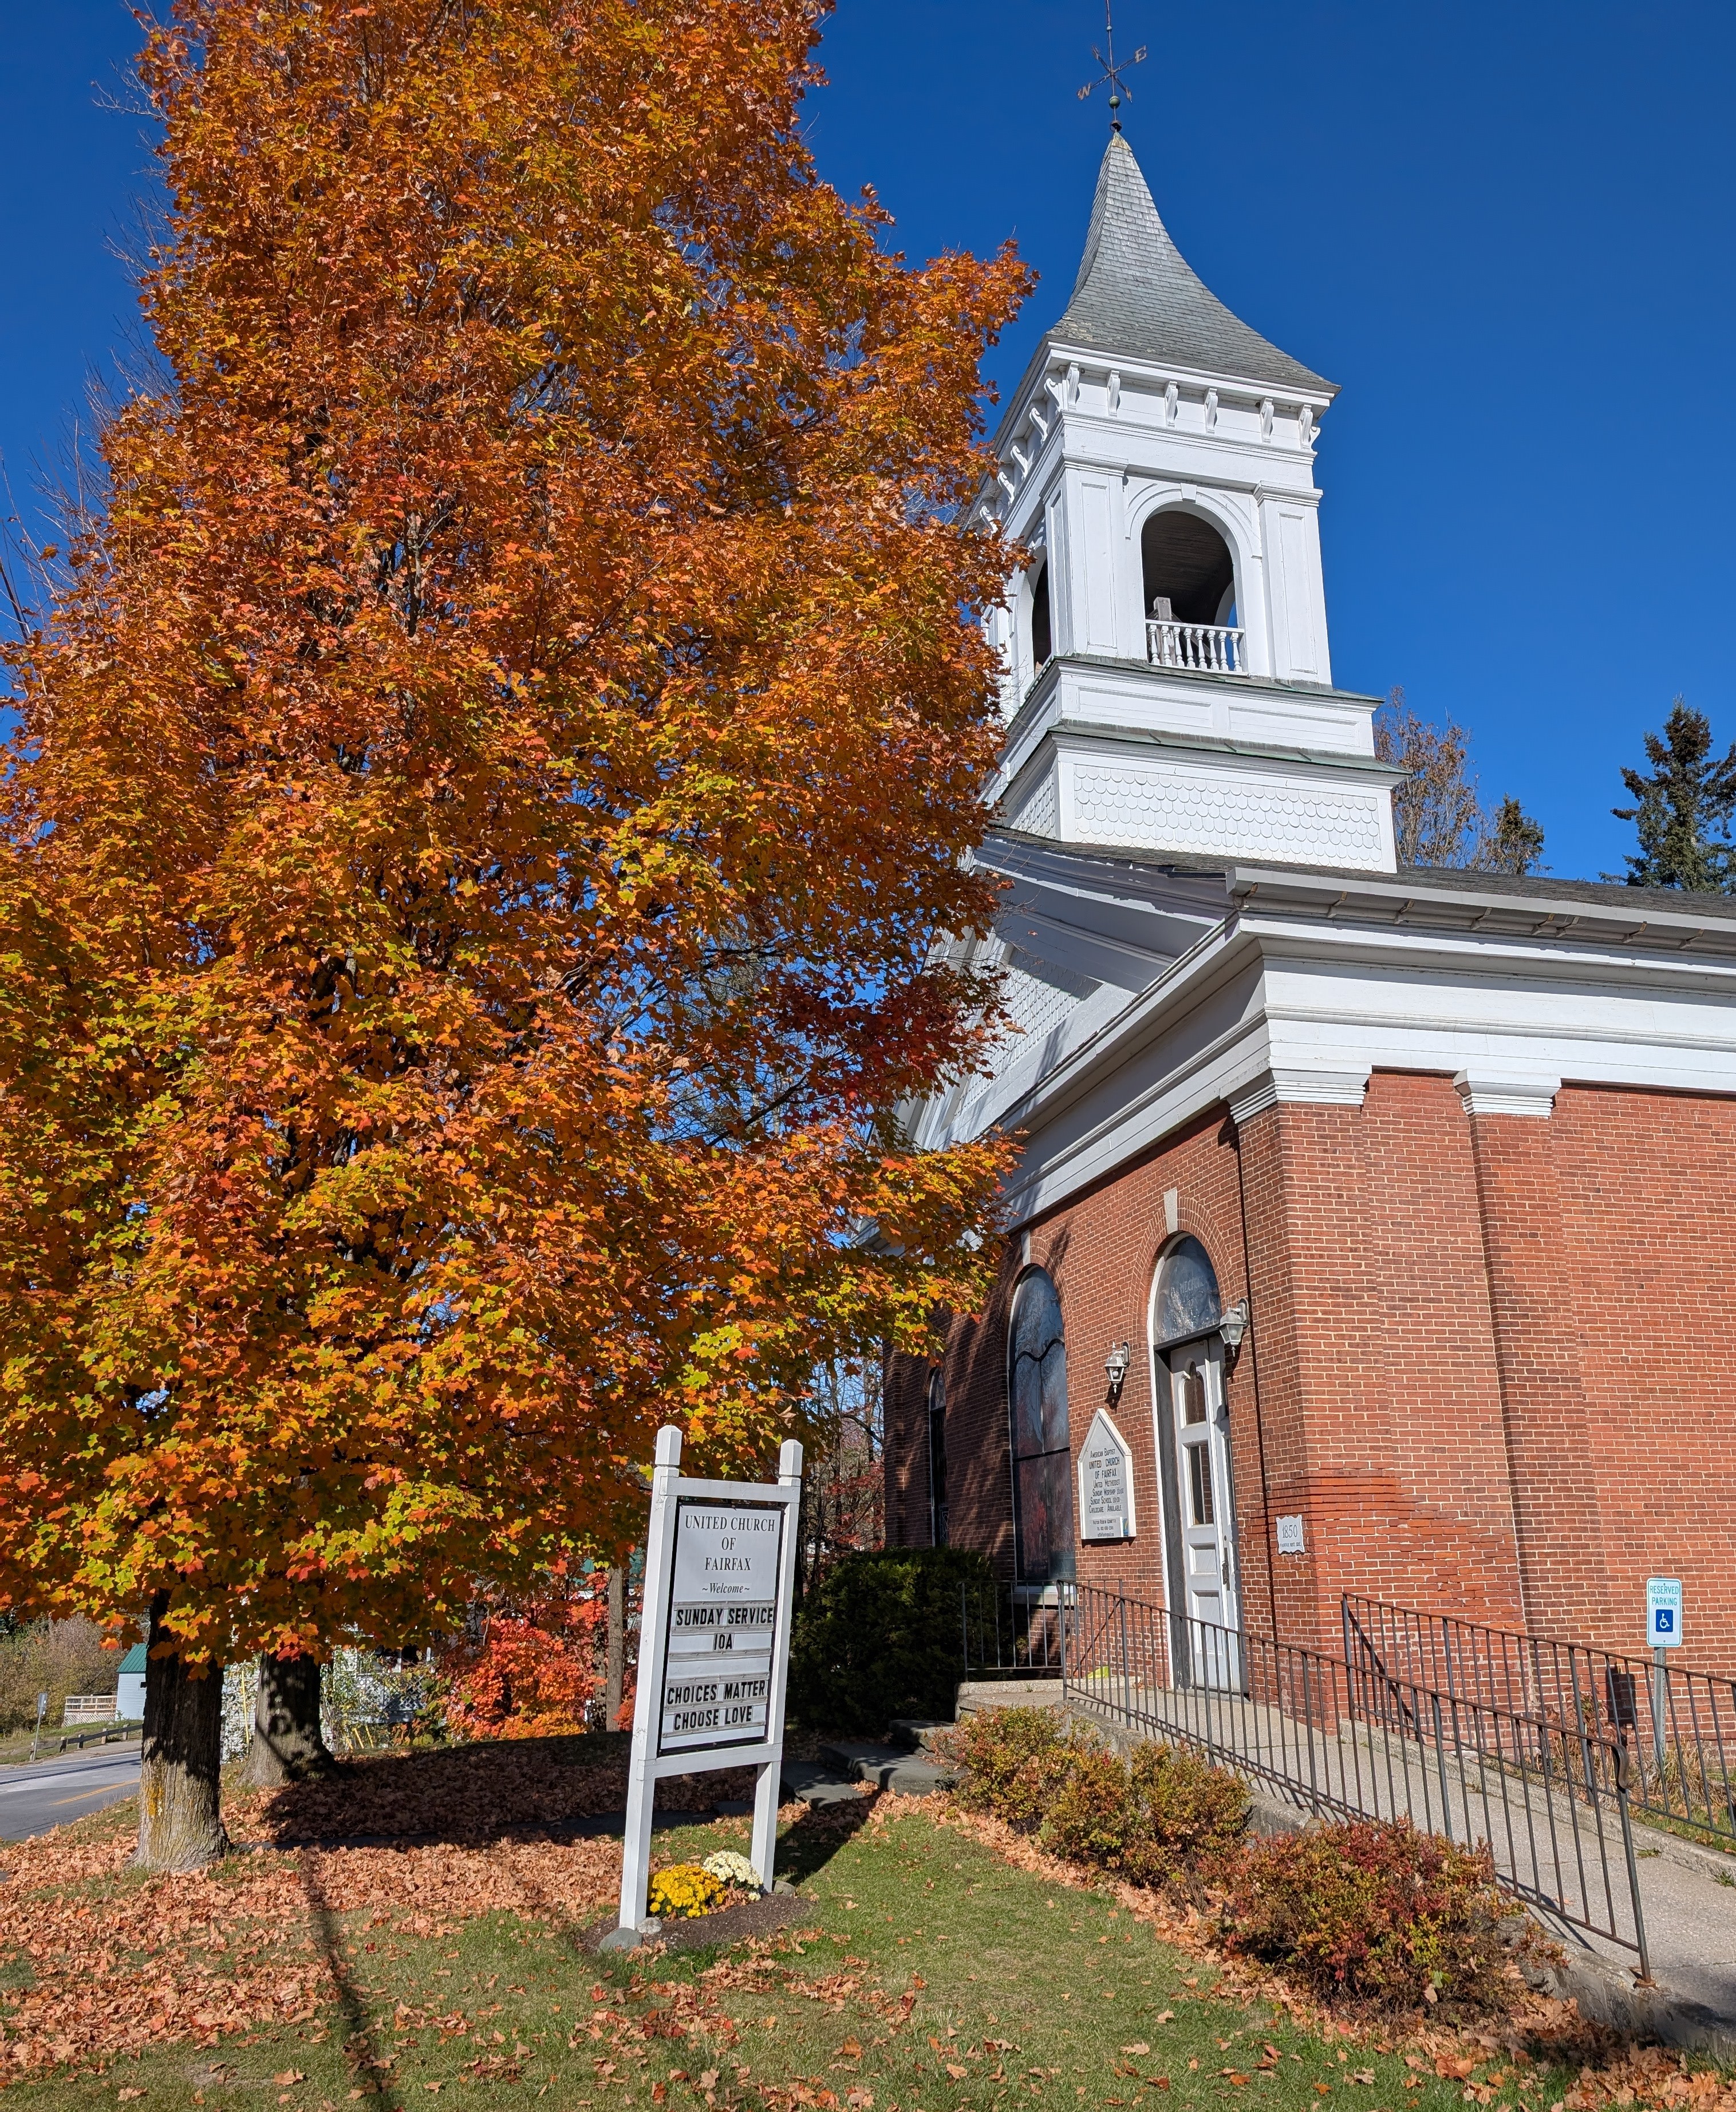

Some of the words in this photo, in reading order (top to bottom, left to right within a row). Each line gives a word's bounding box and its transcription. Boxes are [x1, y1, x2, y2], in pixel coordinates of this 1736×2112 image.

[1088, 1460, 1102, 1470] UNITED
[1106, 1456, 1120, 1467] CHURCH
[1095, 1470, 1100, 1479] OF
[1102, 1468, 1117, 1478] FAIRFAX
[1100, 1495, 1112, 1504] SCHOOL
[685, 1515, 727, 1530] UNITED
[731, 1517, 775, 1532] CHURCH
[1282, 1524, 1298, 1538] 1850
[721, 1537, 736, 1550] OF
[704, 1557, 751, 1571] FAIRFAX
[1650, 1586, 1679, 1594] RESERVED
[1652, 1597, 1677, 1605] PARKING
[676, 1609, 723, 1626] SUNDAY
[728, 1608, 774, 1624] SERVICE
[667, 1684, 717, 1705] CHOICES
[724, 1680, 766, 1700] MATTER
[674, 1708, 719, 1731] CHOOSE
[724, 1705, 752, 1724] LOVE
